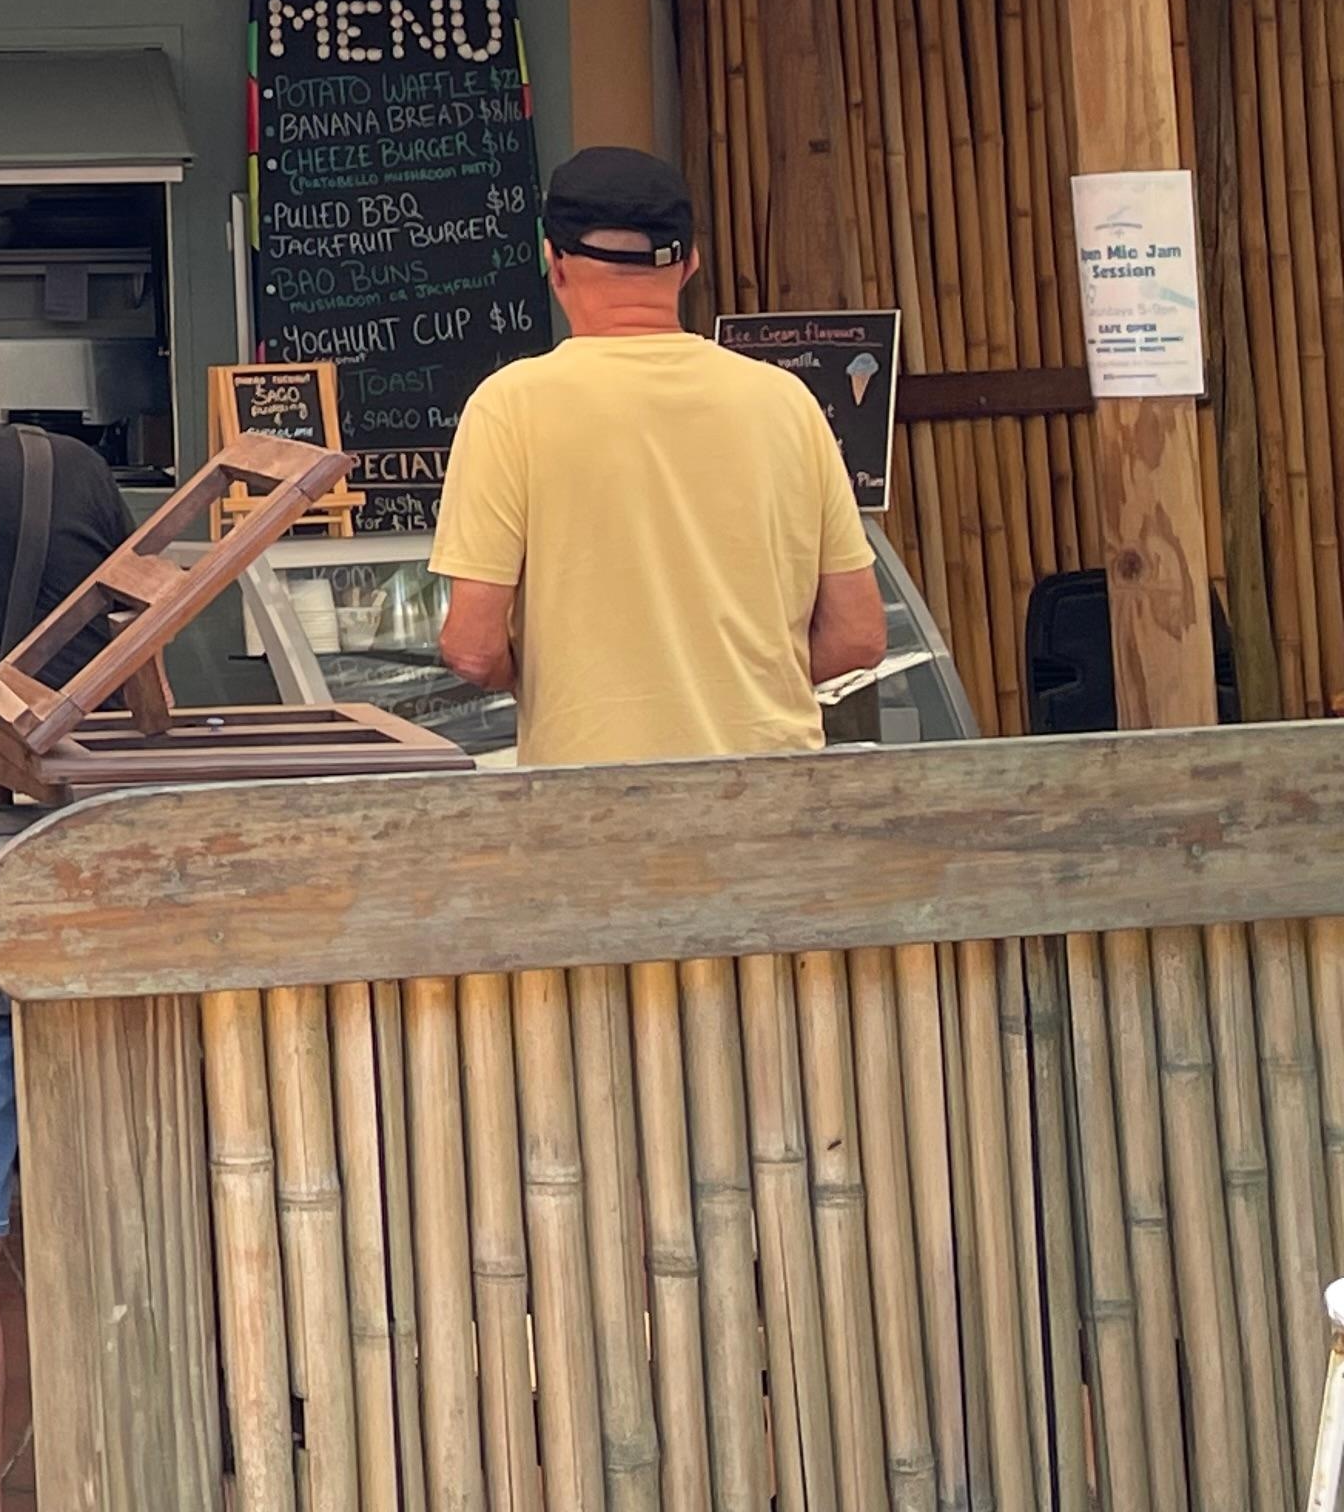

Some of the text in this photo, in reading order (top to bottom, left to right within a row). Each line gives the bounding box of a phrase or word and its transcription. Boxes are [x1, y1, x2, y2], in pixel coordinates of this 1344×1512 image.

[275, 74, 372, 109] POTATO
[382, 71, 486, 104] WAFFLE
[279, 110, 380, 144] BANANA
[386, 101, 475, 133] BREAD
[280, 127, 520, 177] CHEEZE BURGER $16
[384, 166, 458, 184] MUSHROOM
[272, 182, 526, 233] PULLED BBQ $18
[268, 213, 509, 260] JACKFRUIT BURGER
[1106, 244, 1139, 260] Mic
[1145, 244, 1183, 259] Jam
[270, 242, 533, 302] BAO BUNS $20
[1091, 262, 1157, 279] Session
[289, 270, 499, 314] MUSHROOM OR JACKFRUIT
[280, 298, 534, 365] YOGHURT CUP $16
[723, 321, 866, 345] Ice Cream flavours
[776, 350, 822, 369] vanilla
[250, 384, 301, 406] SAGO
[351, 364, 445, 404] TOAST
[361, 408, 422, 431] SAGO
[390, 512, 429, 532] $15
